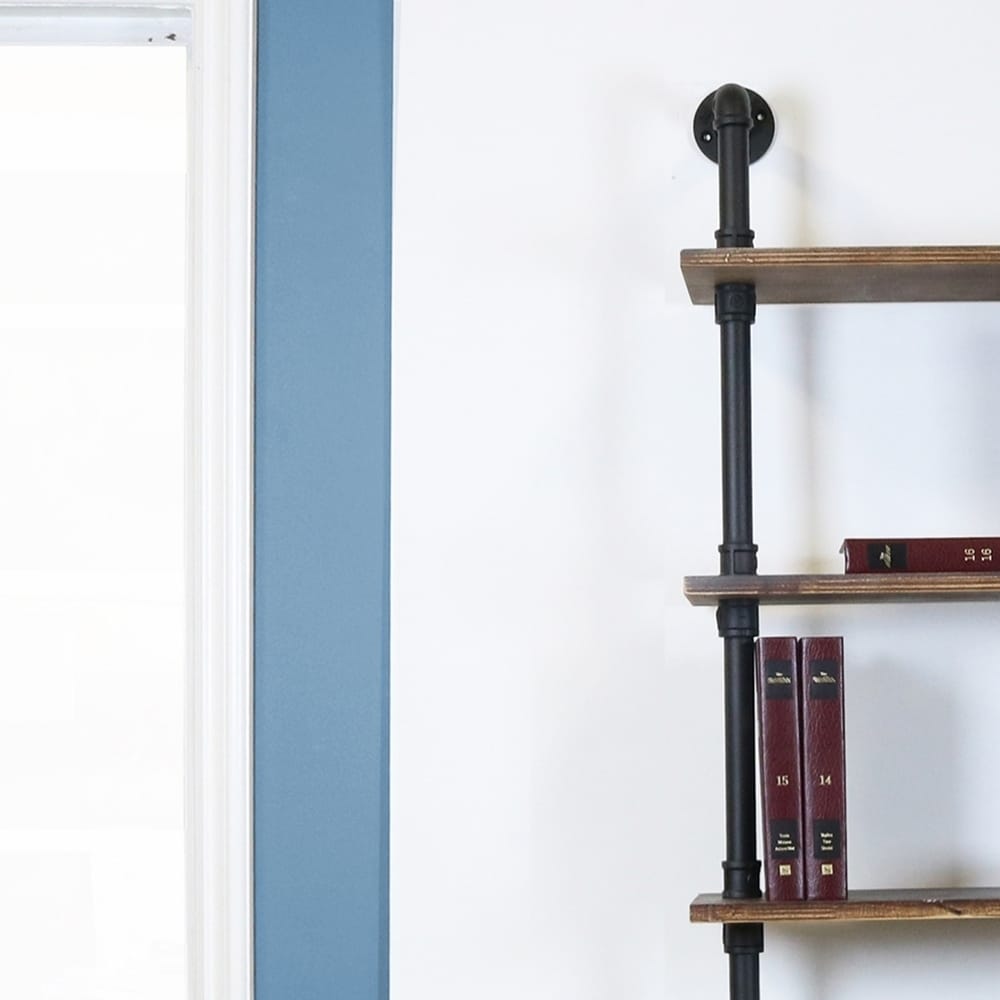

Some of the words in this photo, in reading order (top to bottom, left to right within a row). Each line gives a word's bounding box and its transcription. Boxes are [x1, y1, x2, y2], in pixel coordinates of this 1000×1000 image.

[964, 547, 976, 562] 16
[980, 547, 993, 562] 16
[776, 775, 789, 785] 15
[819, 775, 832, 785] 14
